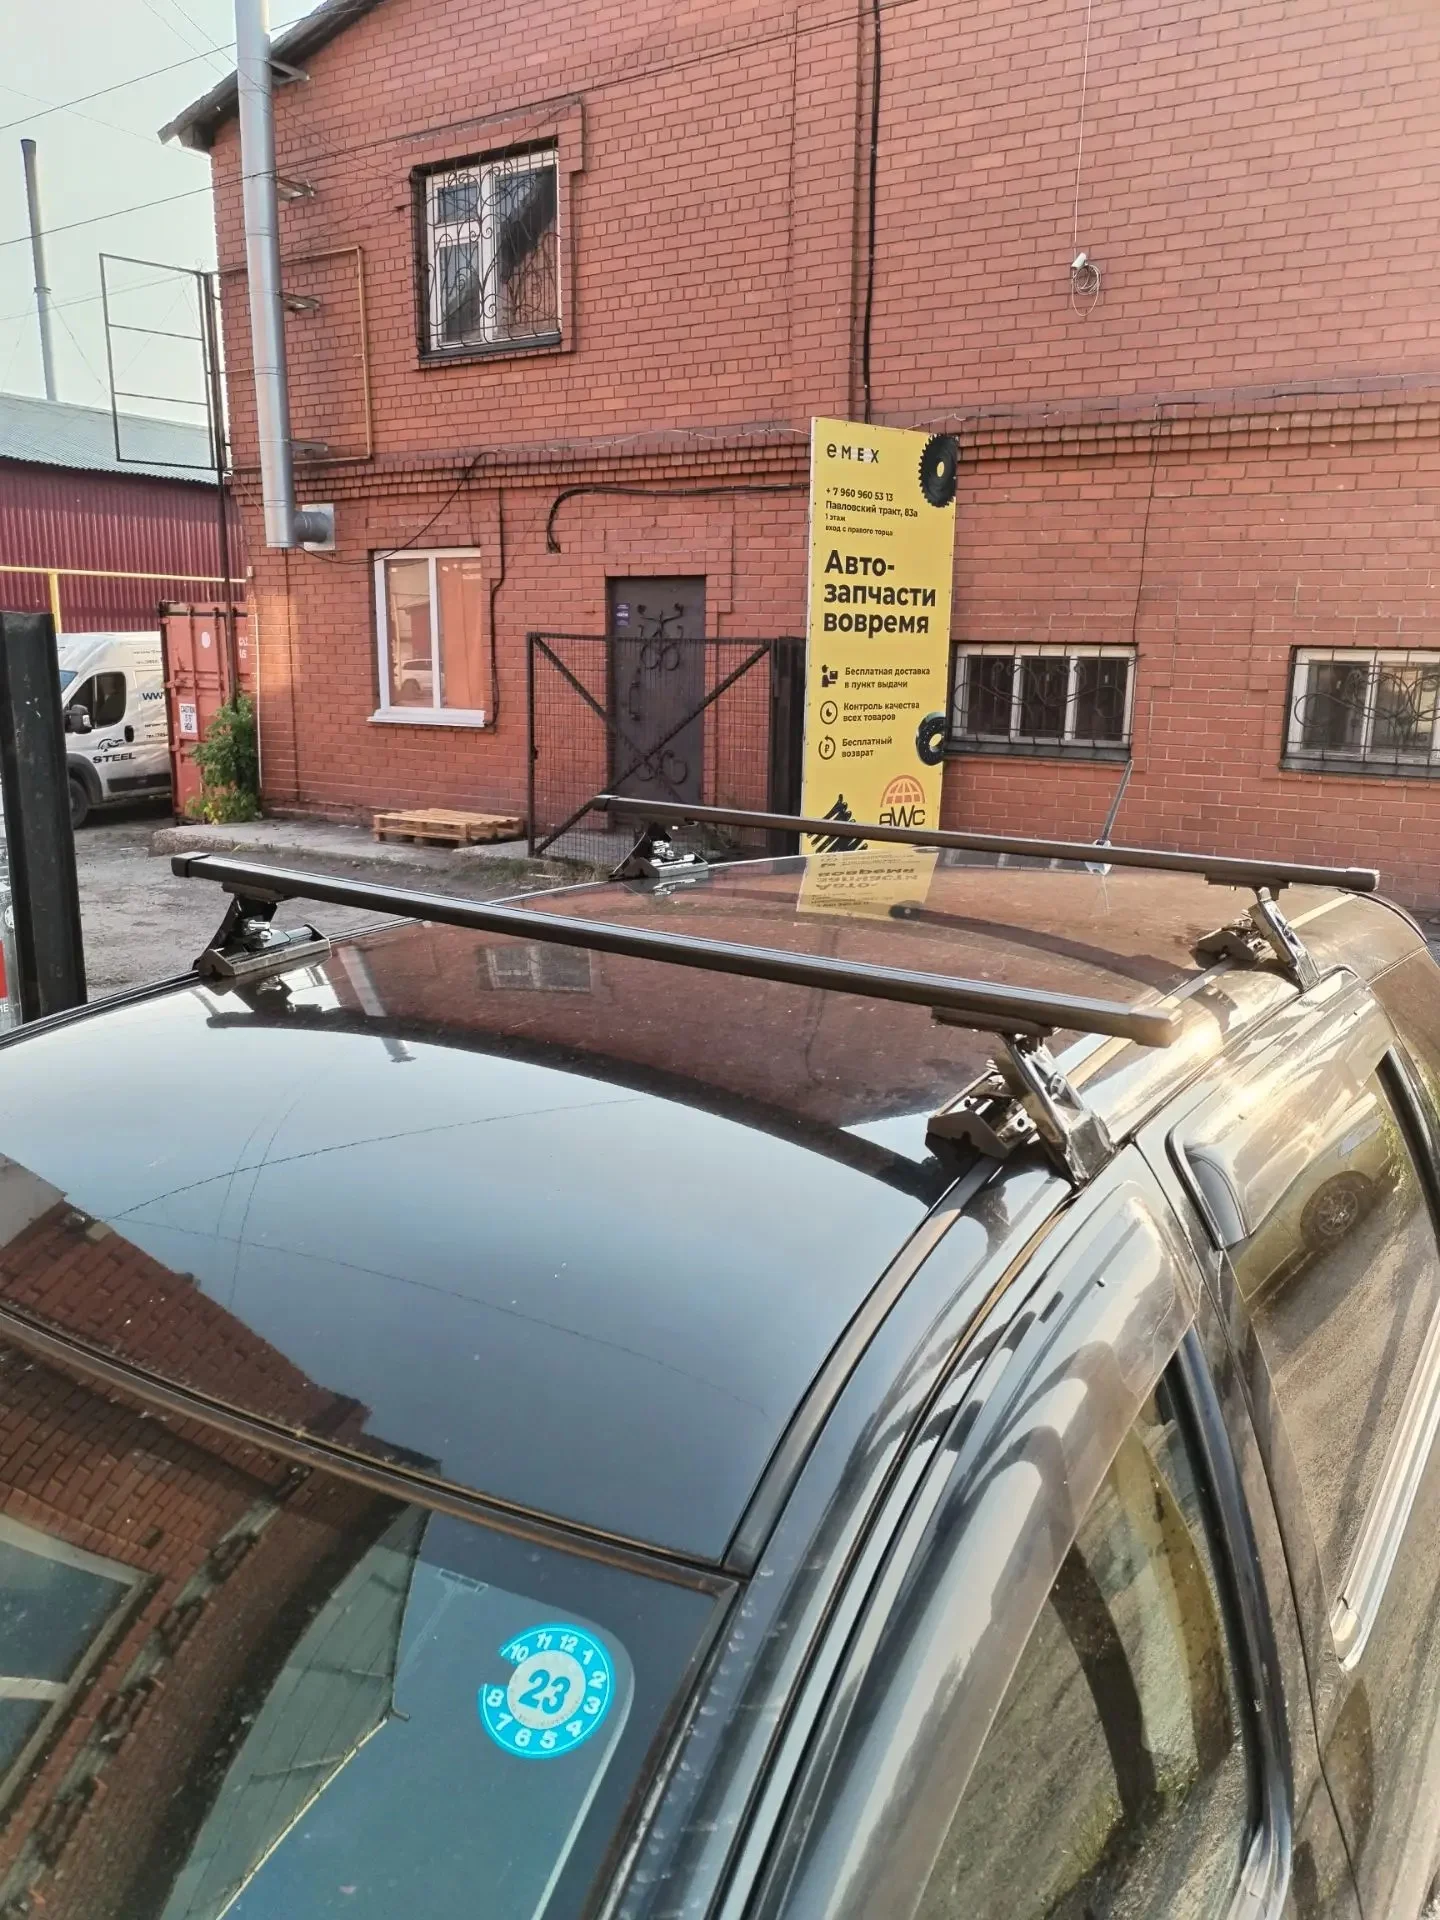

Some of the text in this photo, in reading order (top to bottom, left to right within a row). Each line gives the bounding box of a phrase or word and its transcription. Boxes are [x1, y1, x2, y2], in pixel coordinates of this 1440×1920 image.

[833, 487, 838, 496] 7
[840, 488, 856, 498] 960
[857, 490, 873, 499] 960
[874, 492, 884, 501] 53
[885, 493, 894, 502] 13
[825, 500, 877, 513] Павловский
[879, 507, 903, 517] тракт,
[825, 525, 841, 533] вход
[848, 527, 874, 535] правого
[824, 550, 895, 577] Авто-
[824, 583, 936, 607] запчасти
[823, 613, 929, 639] вовремя
[845, 667, 931, 677] Бесплатная доставка
[851, 681, 875, 690] пункт
[877, 681, 908, 689] выдачи
[843, 702, 920, 712] Контроль качества
[843, 713, 896, 722] всех товаров
[842, 736, 893, 747] Бесплатный
[93, 752, 136, 764] STEEL
[841, 749, 874, 759] возврат
[537, 1632, 553, 1649] 11
[560, 1634, 578, 1652] 12
[509, 1643, 529, 1662] 10
[583, 1650, 594, 1665] 1
[588, 1671, 607, 1689] 2
[487, 1689, 505, 1707] 8
[518, 1669, 571, 1716] 23
[583, 1697, 601, 1715] 3
[496, 1713, 513, 1731] 7
[566, 1720, 583, 1737] 4
[515, 1729, 532, 1747] 6
[540, 1730, 558, 1749] 5
